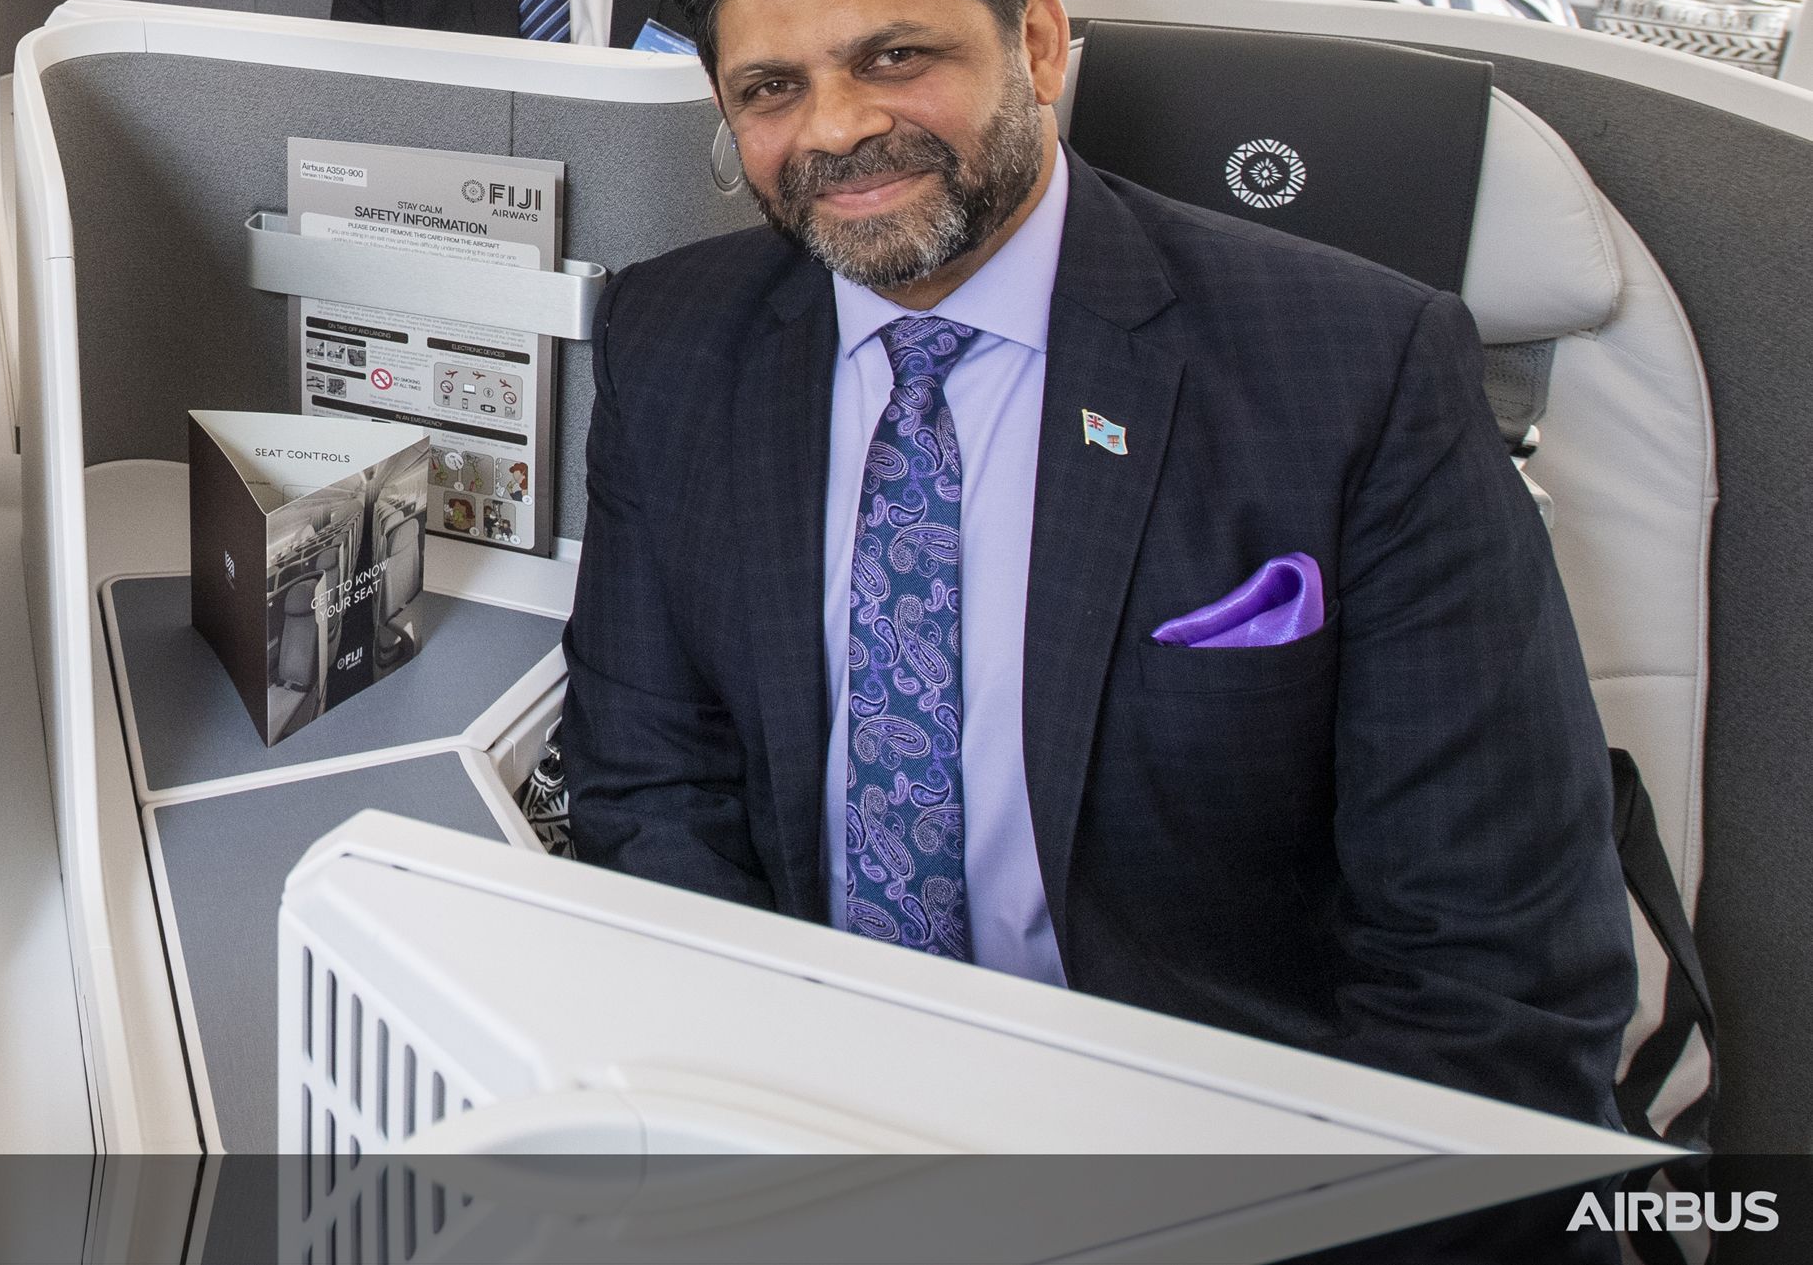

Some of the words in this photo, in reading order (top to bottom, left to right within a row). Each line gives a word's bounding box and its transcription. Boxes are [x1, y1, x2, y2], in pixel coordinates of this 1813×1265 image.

[302, 162, 325, 173] Airbus
[326, 166, 364, 178] A350-900
[489, 183, 542, 211] FIJI
[397, 200, 418, 211] STAY
[419, 204, 443, 215] CALM
[492, 209, 538, 222] AIRWAYS
[354, 206, 400, 223] SAFETY
[403, 213, 487, 235] INFORMATION
[348, 222, 368, 231] PLEASE
[390, 228, 413, 237] REMOVE
[444, 235, 459, 243] FROM
[473, 240, 500, 249] AIRCRAFT
[451, 343, 483, 354] ELECTRONIC
[484, 349, 506, 358] DEVICES
[410, 416, 443, 427] EMERGENCY
[255, 447, 283, 458] SEAT
[286, 450, 351, 463] CONTROLS
[310, 588, 334, 610] GET
[336, 579, 352, 596] TO
[355, 558, 389, 586] KNOW
[320, 596, 351, 621] YOUR
[354, 579, 381, 604] SEAT
[345, 646, 363, 665] FIJI
